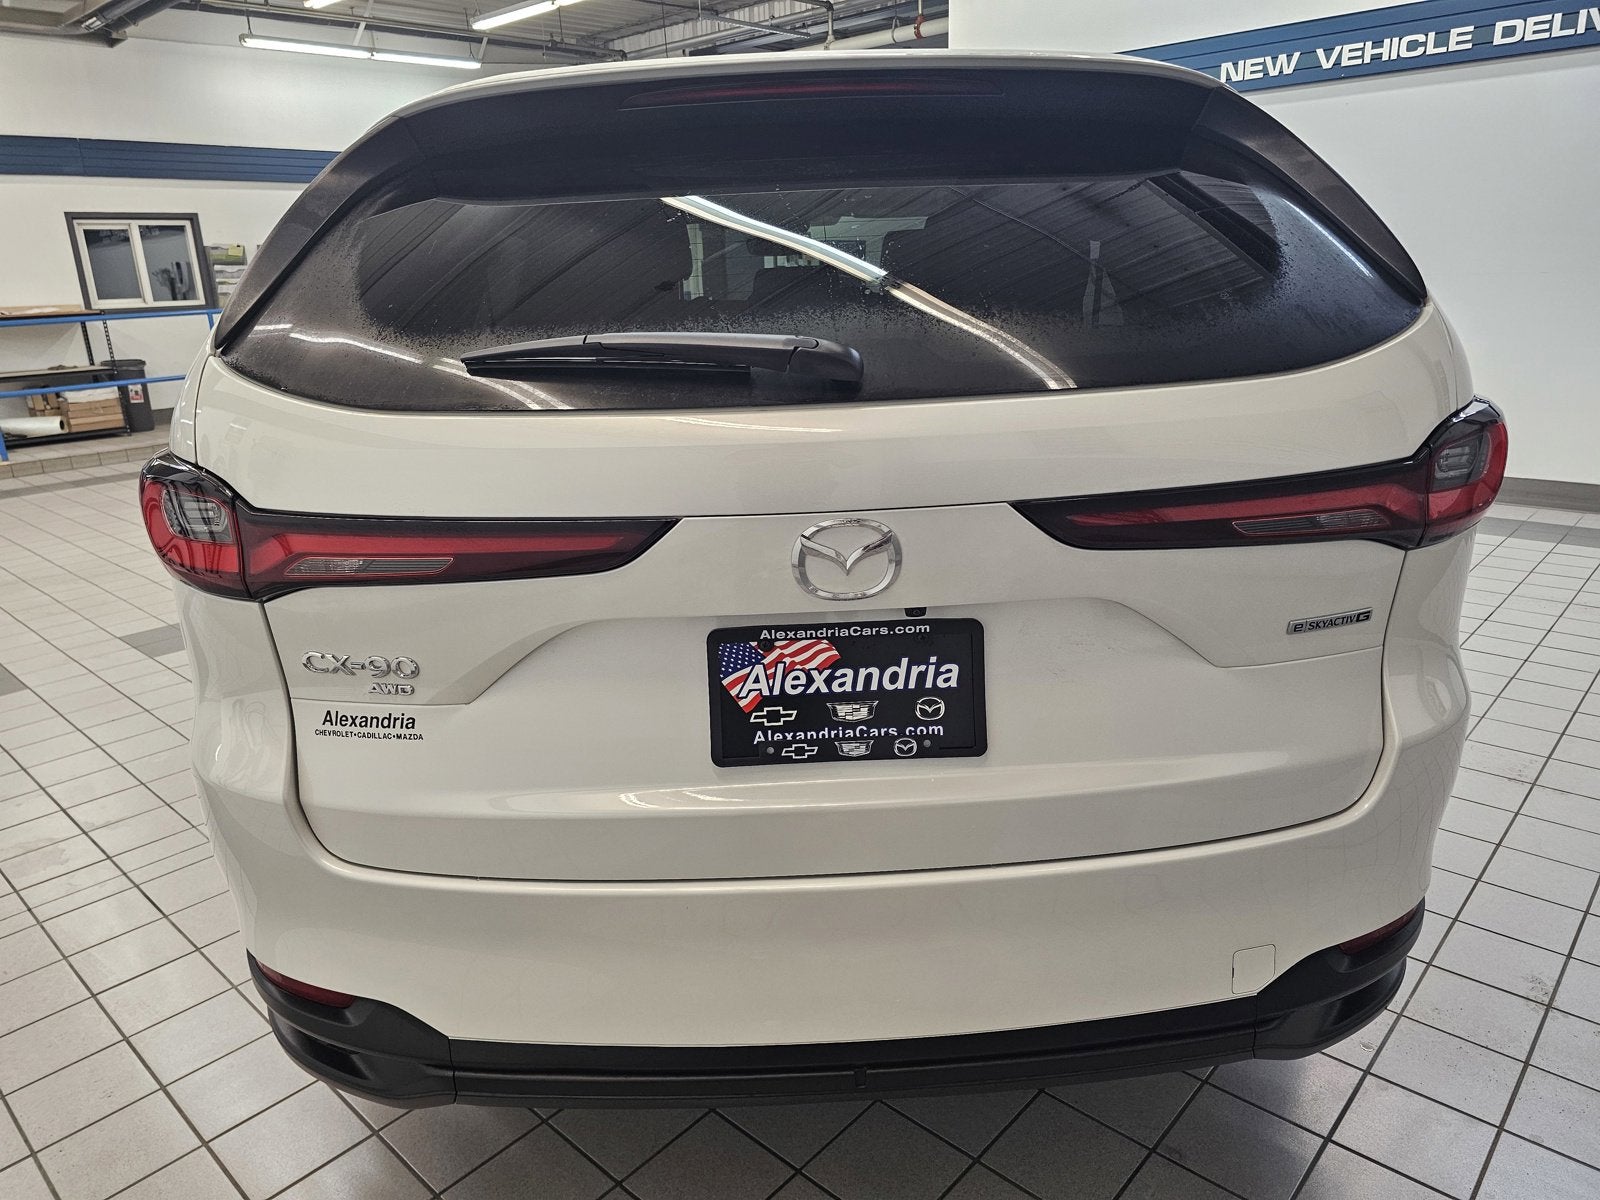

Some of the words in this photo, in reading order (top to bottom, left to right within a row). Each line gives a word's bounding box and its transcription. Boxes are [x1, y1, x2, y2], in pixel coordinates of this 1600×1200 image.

[1220, 51, 1302, 84] NEW
[1316, 24, 1475, 70] VEHICLE
[760, 623, 931, 640] AlexandriaCars.com
[301, 650, 421, 680] CX-90
[738, 656, 960, 698] Alexandria
[367, 682, 416, 696] AWD
[321, 709, 416, 730] Alexandria
[753, 725, 945, 745] AlexandriaCarscom
